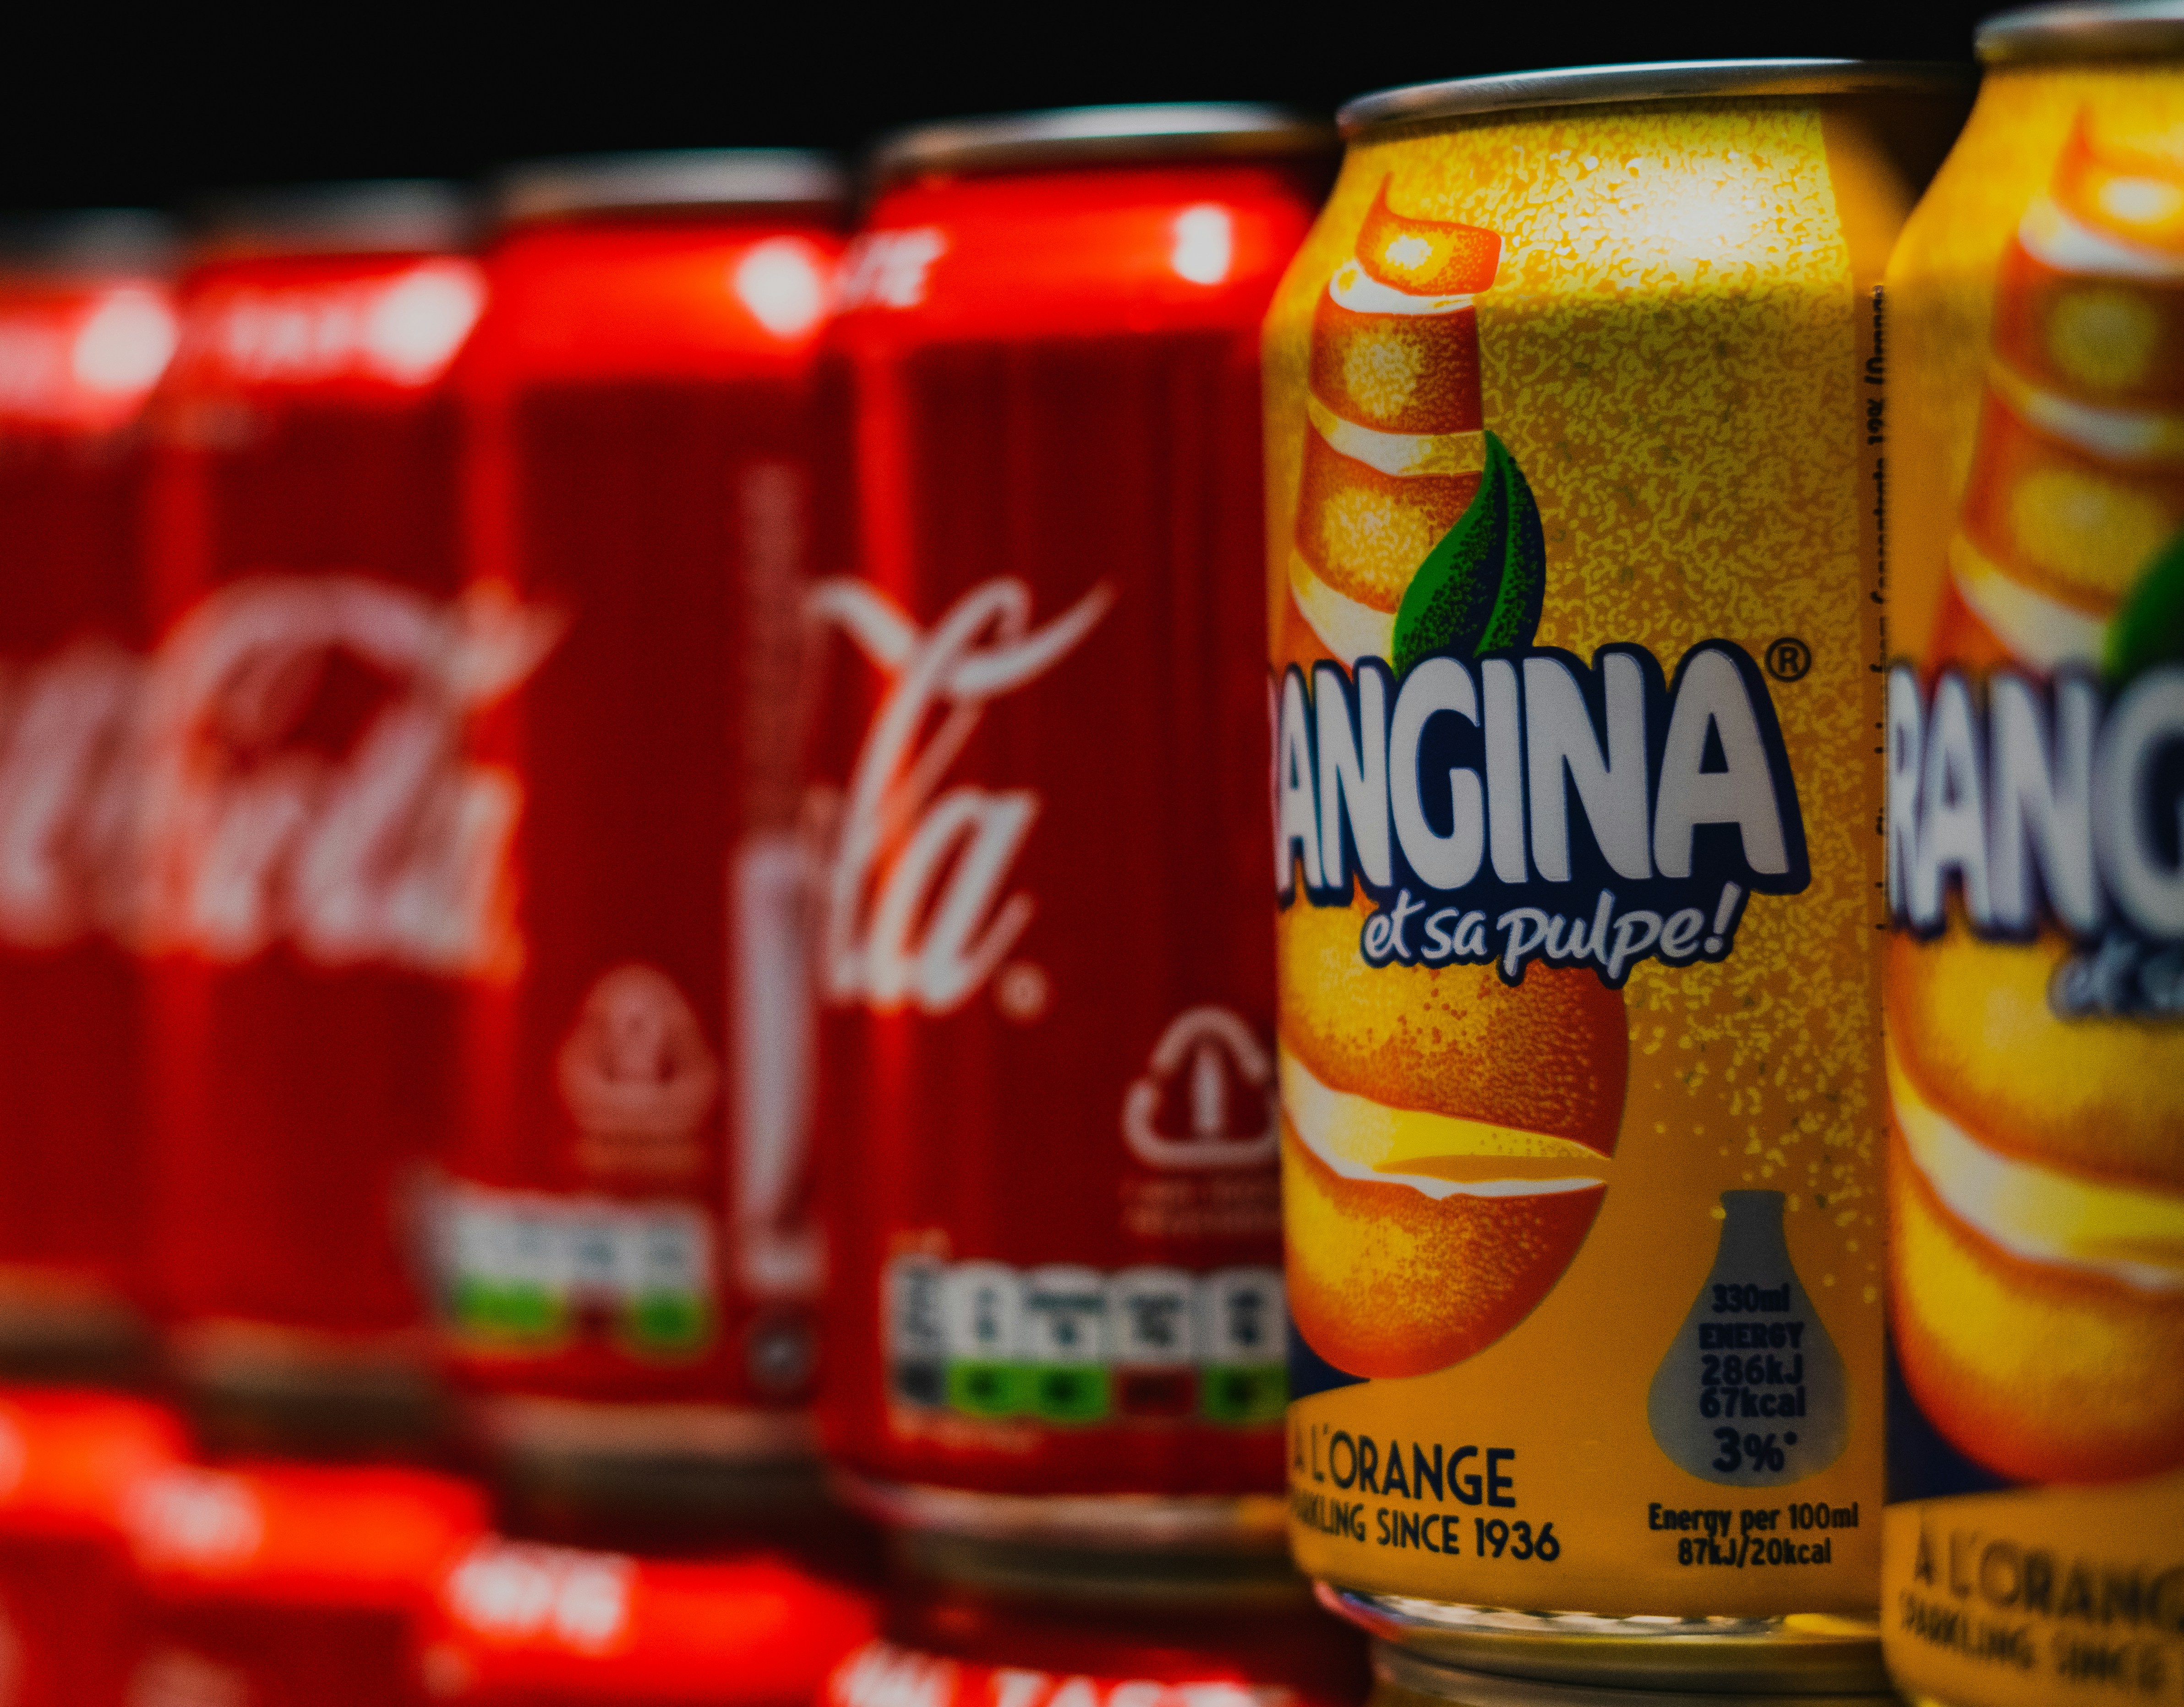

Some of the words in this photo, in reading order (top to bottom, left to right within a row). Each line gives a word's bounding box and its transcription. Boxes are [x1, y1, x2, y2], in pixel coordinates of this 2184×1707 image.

[1269, 647, 1790, 891] ANGINA
[1365, 888, 1425, 959] et
[1421, 906, 1487, 958] sa
[1496, 881, 1741, 979] pulpe!
[1712, 1284, 1791, 1313] 330ml
[1698, 1322, 1805, 1349] ENERGY
[1701, 1354, 1804, 1386] 286kJ
[1698, 1386, 1806, 1418] 67kcal
[1310, 1422, 1517, 1508] L'ORANGE
[1376, 1506, 1460, 1555] SINCE
[1474, 1516, 1561, 1561] 1936
[1648, 1503, 1732, 1536] Energy
[1741, 1507, 1781, 1536] per
[1788, 1501, 1860, 1530] 100ml
[1677, 1537, 1831, 1568] 87kJ/20kcal
